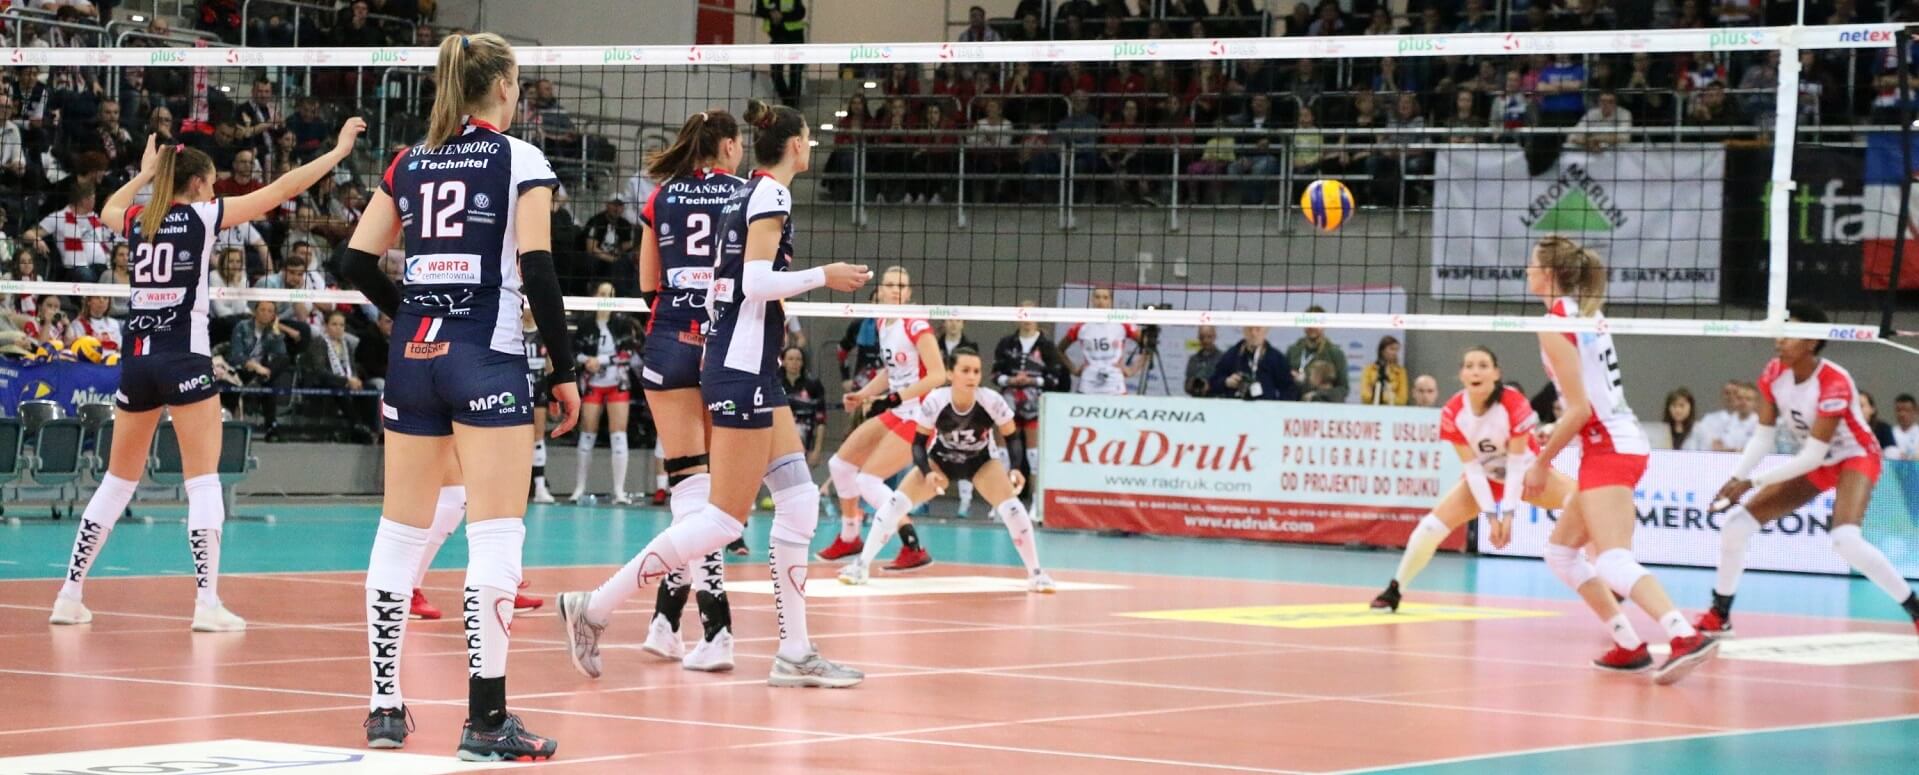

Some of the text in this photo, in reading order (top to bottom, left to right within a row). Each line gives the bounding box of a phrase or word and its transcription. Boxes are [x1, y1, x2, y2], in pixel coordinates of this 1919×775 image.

[1709, 31, 1748, 48] plus
[1839, 29, 1890, 42] netex
[850, 45, 880, 61] plus
[1113, 42, 1145, 58] plus
[1398, 37, 1433, 55] plus
[151, 51, 176, 64] plus
[372, 49, 398, 63] plus
[603, 48, 632, 63] plus
[420, 158, 489, 170] Technitel
[1519, 162, 1628, 228] LEROY MERLIN
[420, 181, 466, 238] 12
[686, 213, 711, 256] 2
[135, 242, 174, 283] 20
[1437, 266, 1523, 279] WSPIERAM
[1829, 326, 1876, 340] netex
[1093, 338, 1110, 351] 16
[754, 386, 764, 407] 6
[1069, 405, 1206, 424] DRUKARNIA
[951, 429, 977, 443] 13
[1283, 418, 1381, 441] KOMPLEKSOWE
[1061, 426, 1258, 472] RaDruk
[1478, 439, 1497, 453] 6
[1282, 445, 1441, 470] POLIGRAFICZNE
[1104, 474, 1252, 492] www.radruk.com
[1281, 472, 1441, 497] OD PROJEKTU DO DRUKU
[1184, 515, 1315, 533] www.radruk.com
